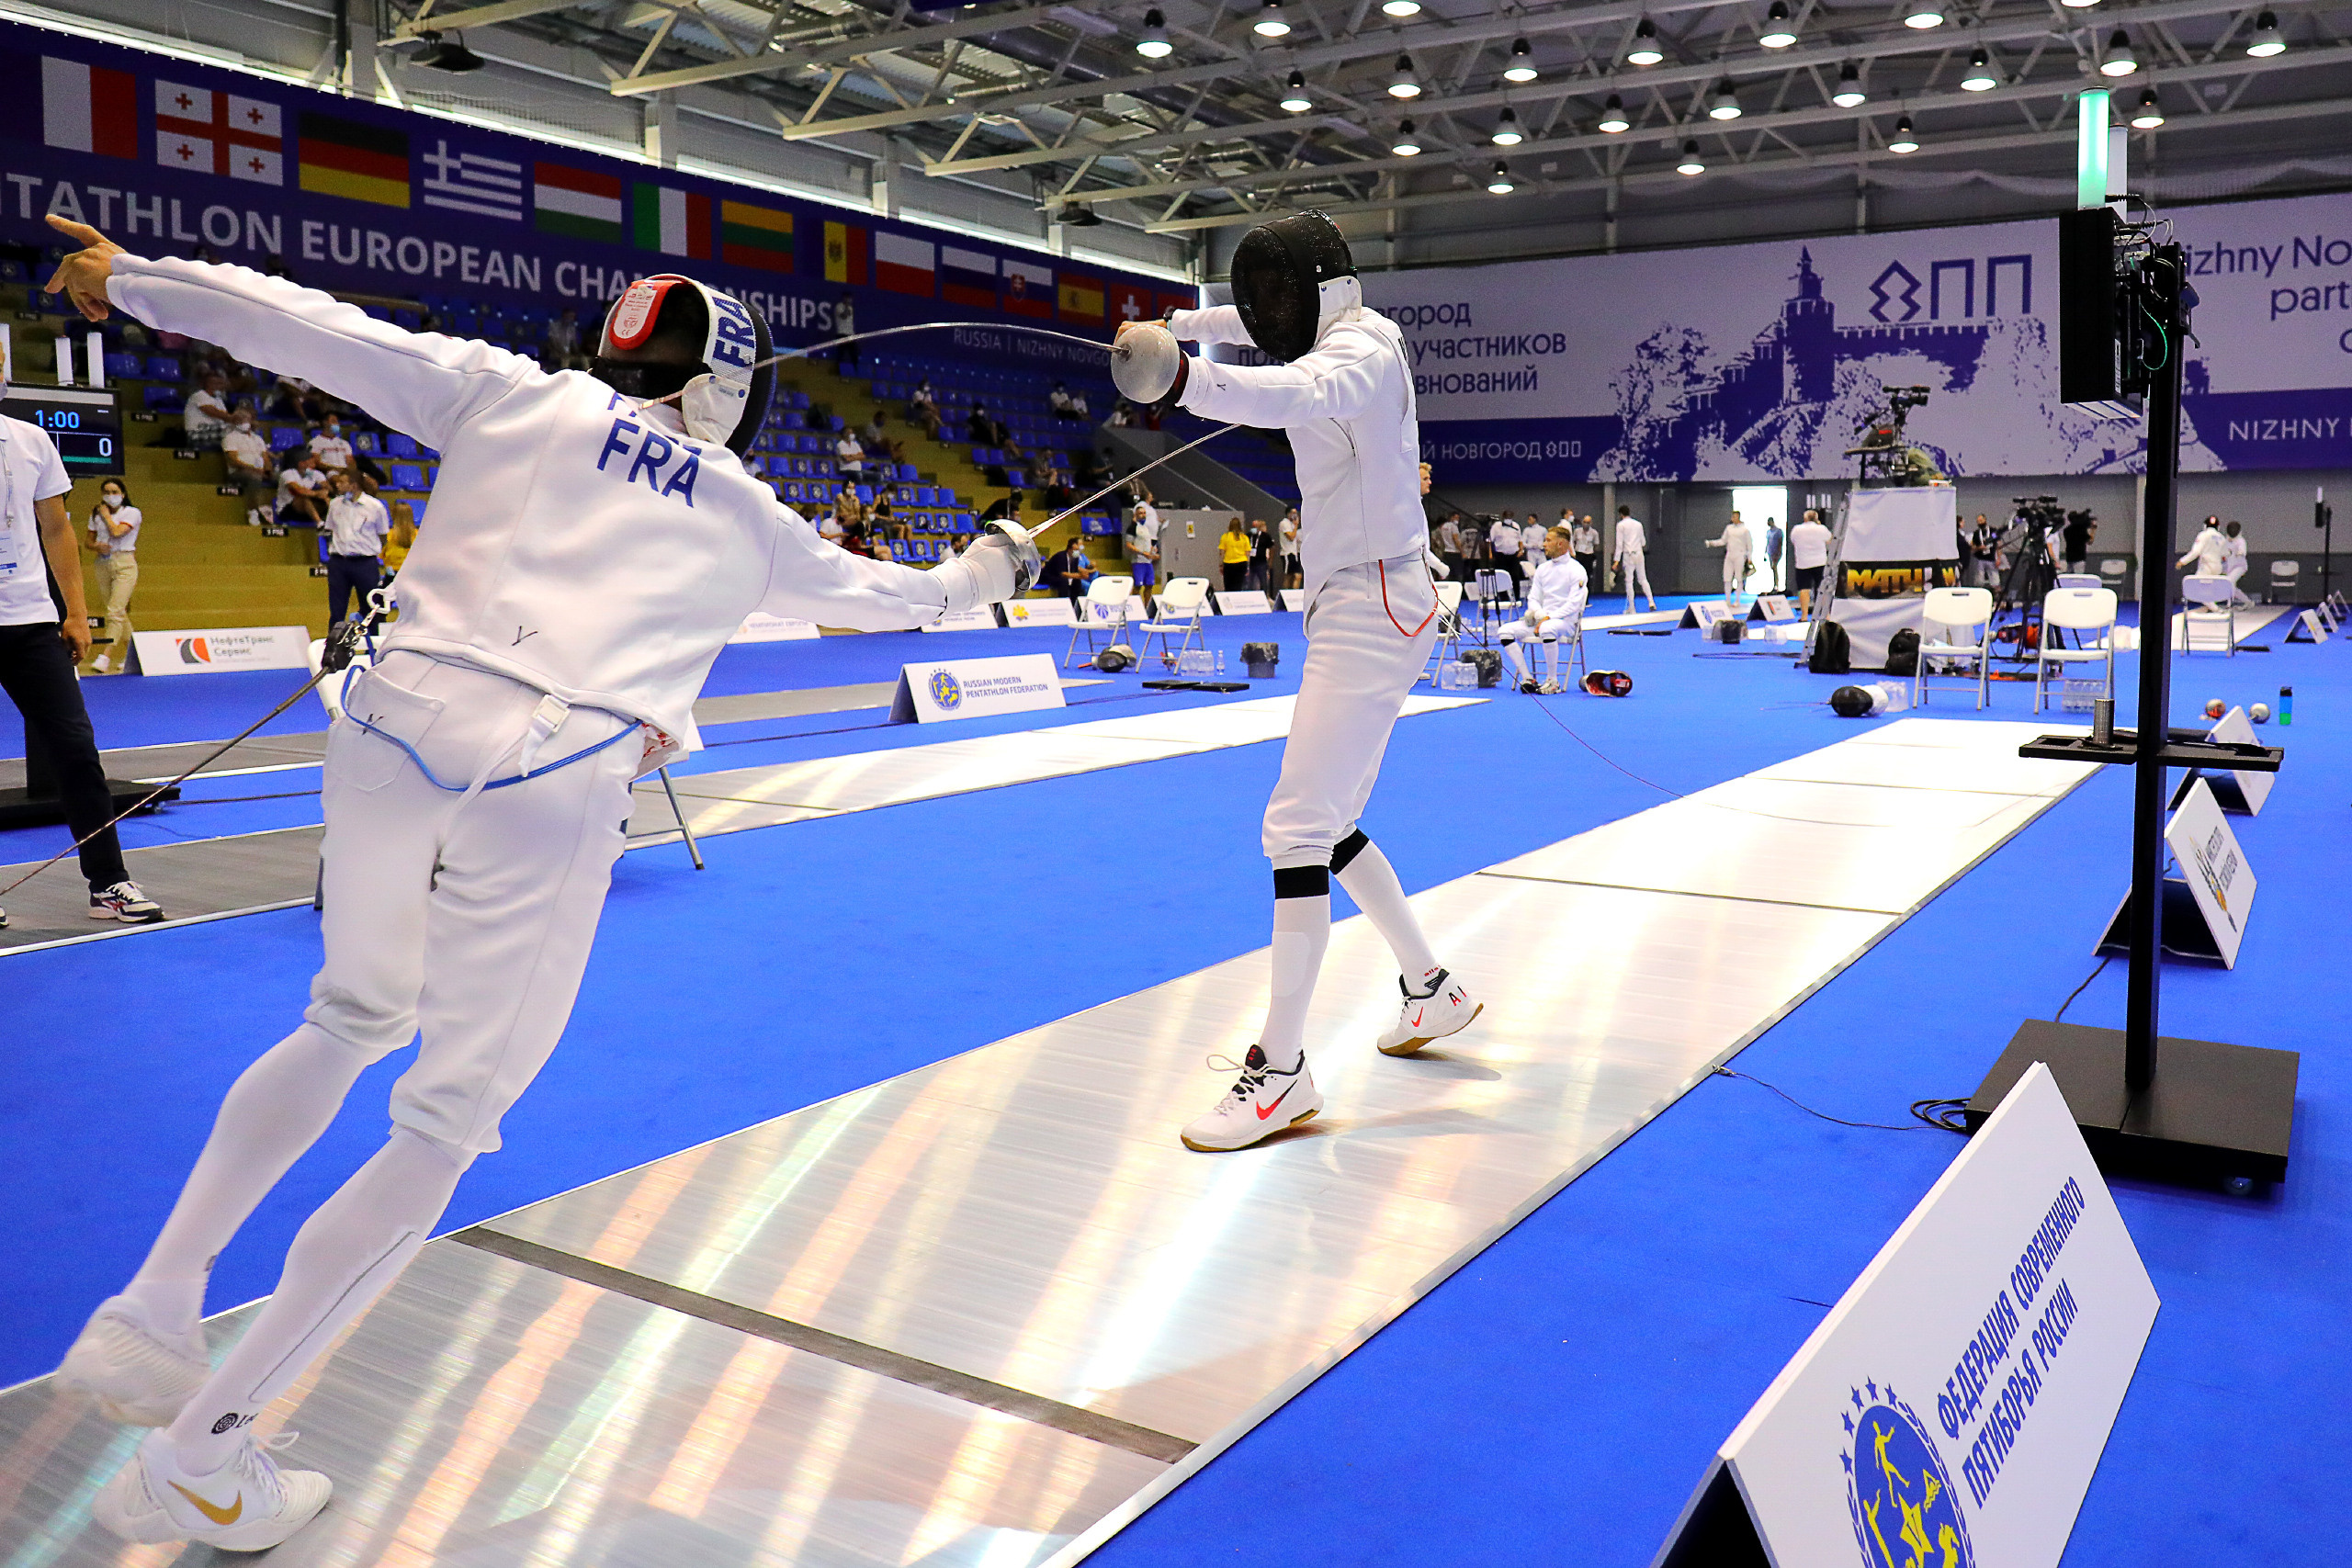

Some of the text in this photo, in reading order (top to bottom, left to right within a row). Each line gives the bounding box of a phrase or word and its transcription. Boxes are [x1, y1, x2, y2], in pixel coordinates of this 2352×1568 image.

[6, 173, 831, 331] TATHLON EUROPEAN CHASHIPS
[713, 296, 756, 368] FRA
[954, 328, 1001, 351] RUSSIA
[1017, 339, 1064, 359] NIZHNY
[1412, 333, 1566, 366] участников
[35, 410, 80, 428] 1:00
[2229, 417, 2339, 441] NIZHNY
[98, 437, 112, 457] 0
[1442, 442, 1542, 460] НОВГОРОД
[596, 418, 699, 508] FRA
[963, 676, 1022, 689] RUSSIAN MODERN
[966, 683, 1048, 698] PENTATHLON FEDERATION
[1938, 1176, 2085, 1440] ФЕДЕРАЦИЯ СОВРЕМЕННОГО
[1962, 1277, 2078, 1510] ПЯТИБОРЬЯ РОССИИ
